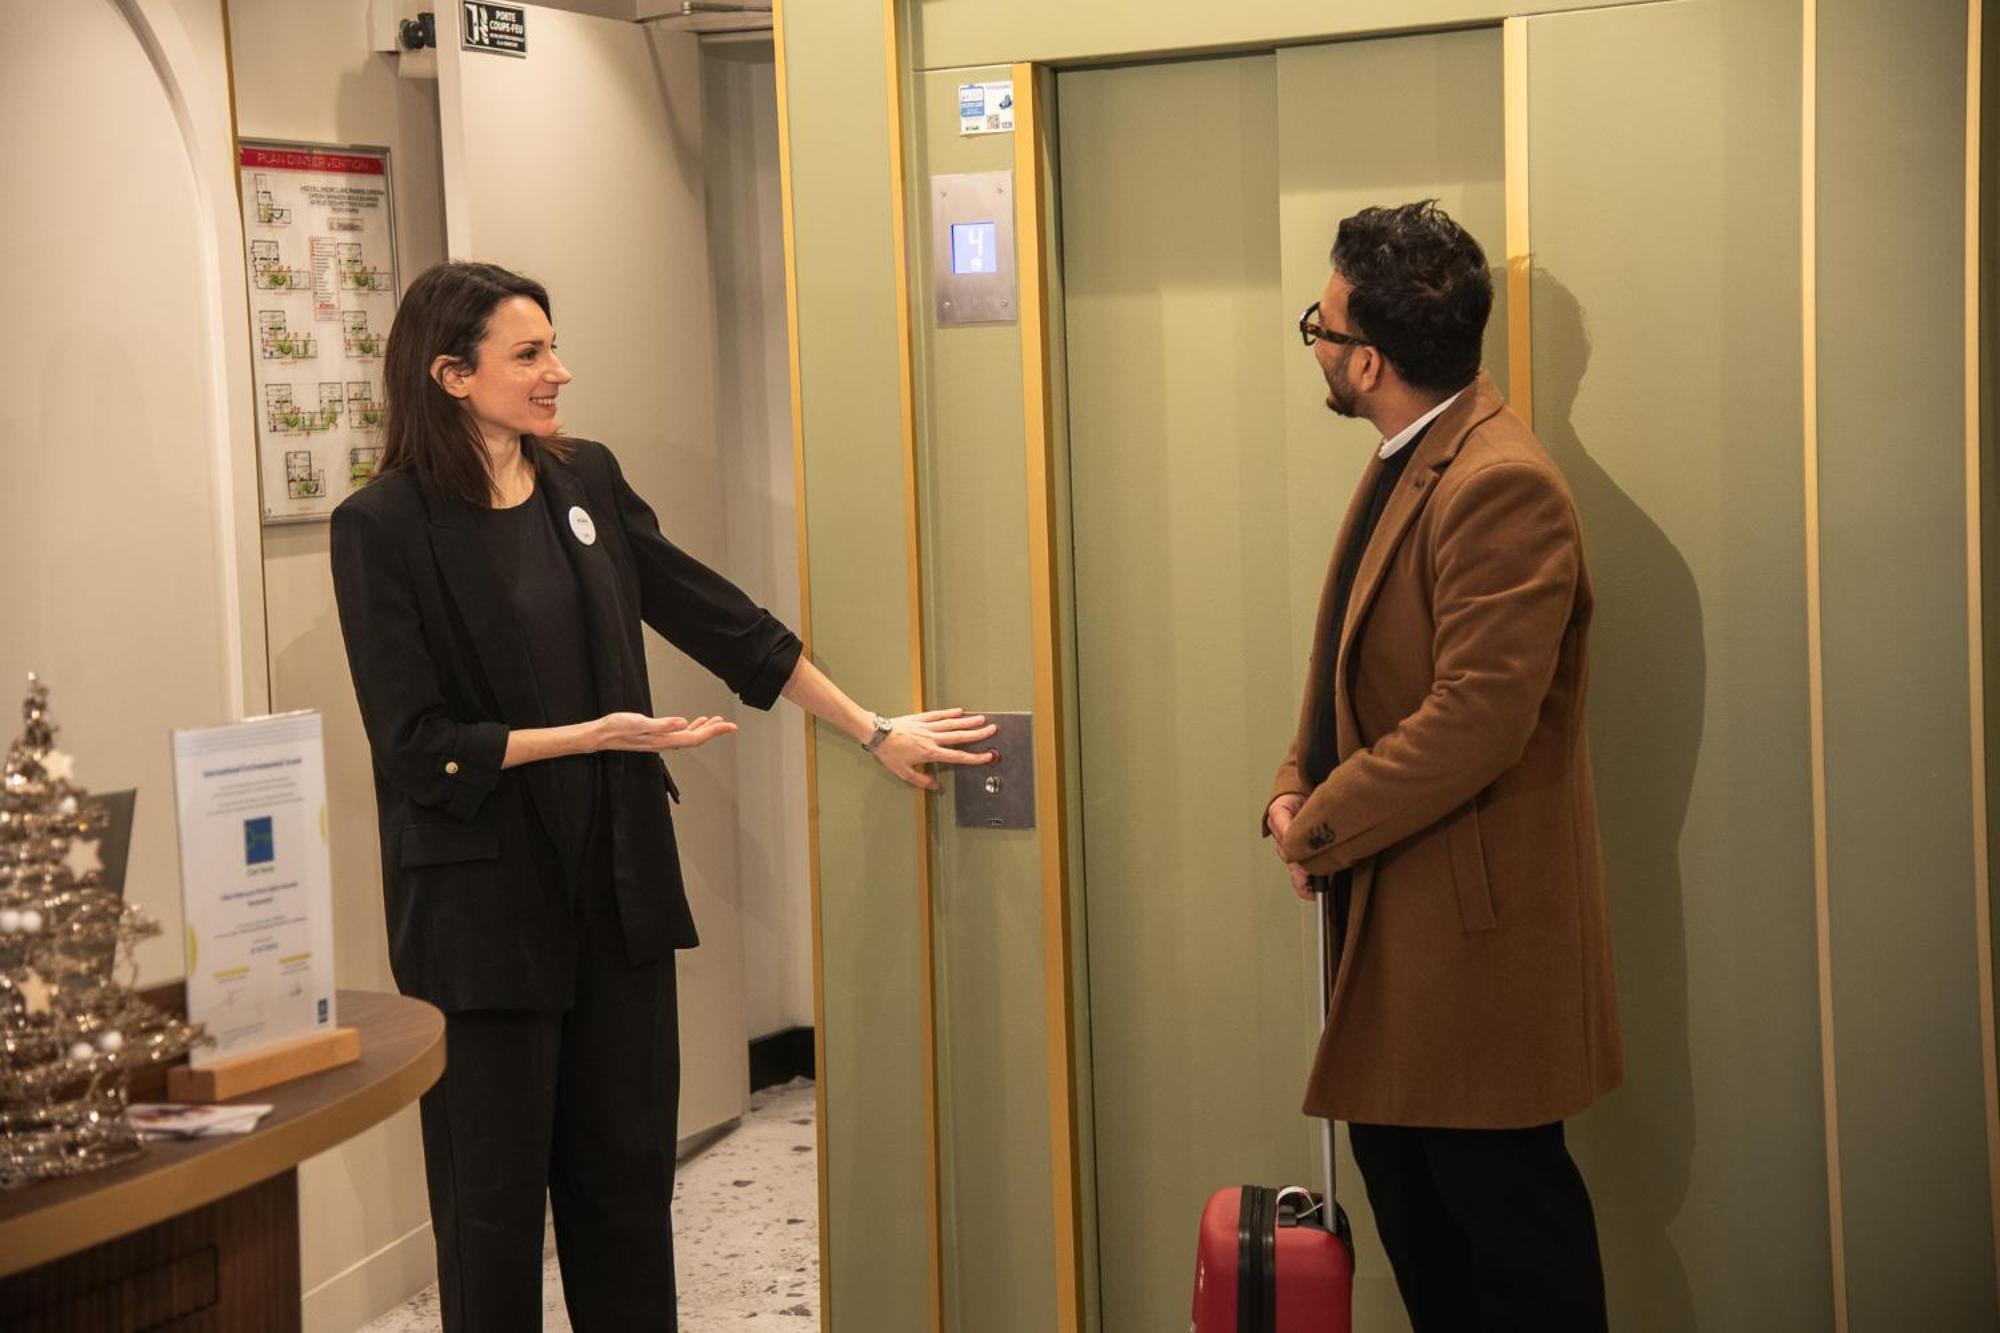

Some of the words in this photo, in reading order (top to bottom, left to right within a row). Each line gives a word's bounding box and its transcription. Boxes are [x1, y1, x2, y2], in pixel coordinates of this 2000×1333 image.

[495, 10, 516, 22] PORTE
[489, 20, 523, 34] COUPE-FEU
[257, 152, 286, 165] PLAN
[969, 228, 983, 256] 4
